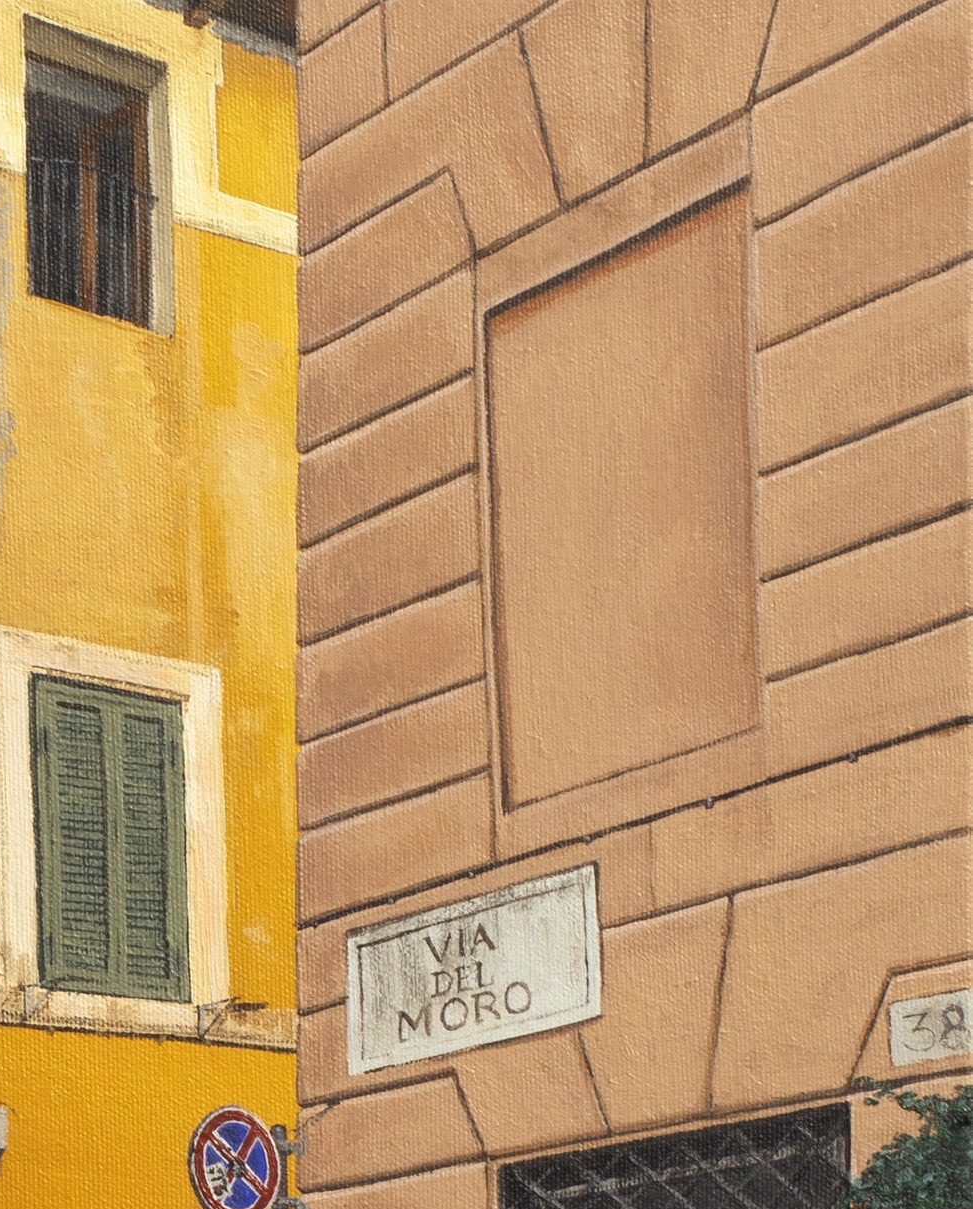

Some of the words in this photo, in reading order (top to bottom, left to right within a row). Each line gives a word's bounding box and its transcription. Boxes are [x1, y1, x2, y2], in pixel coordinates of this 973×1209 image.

[423, 922, 496, 963] VIA
[430, 960, 495, 998] DEL
[397, 981, 532, 1043] MORO
[900, 1002, 972, 1053] 38
